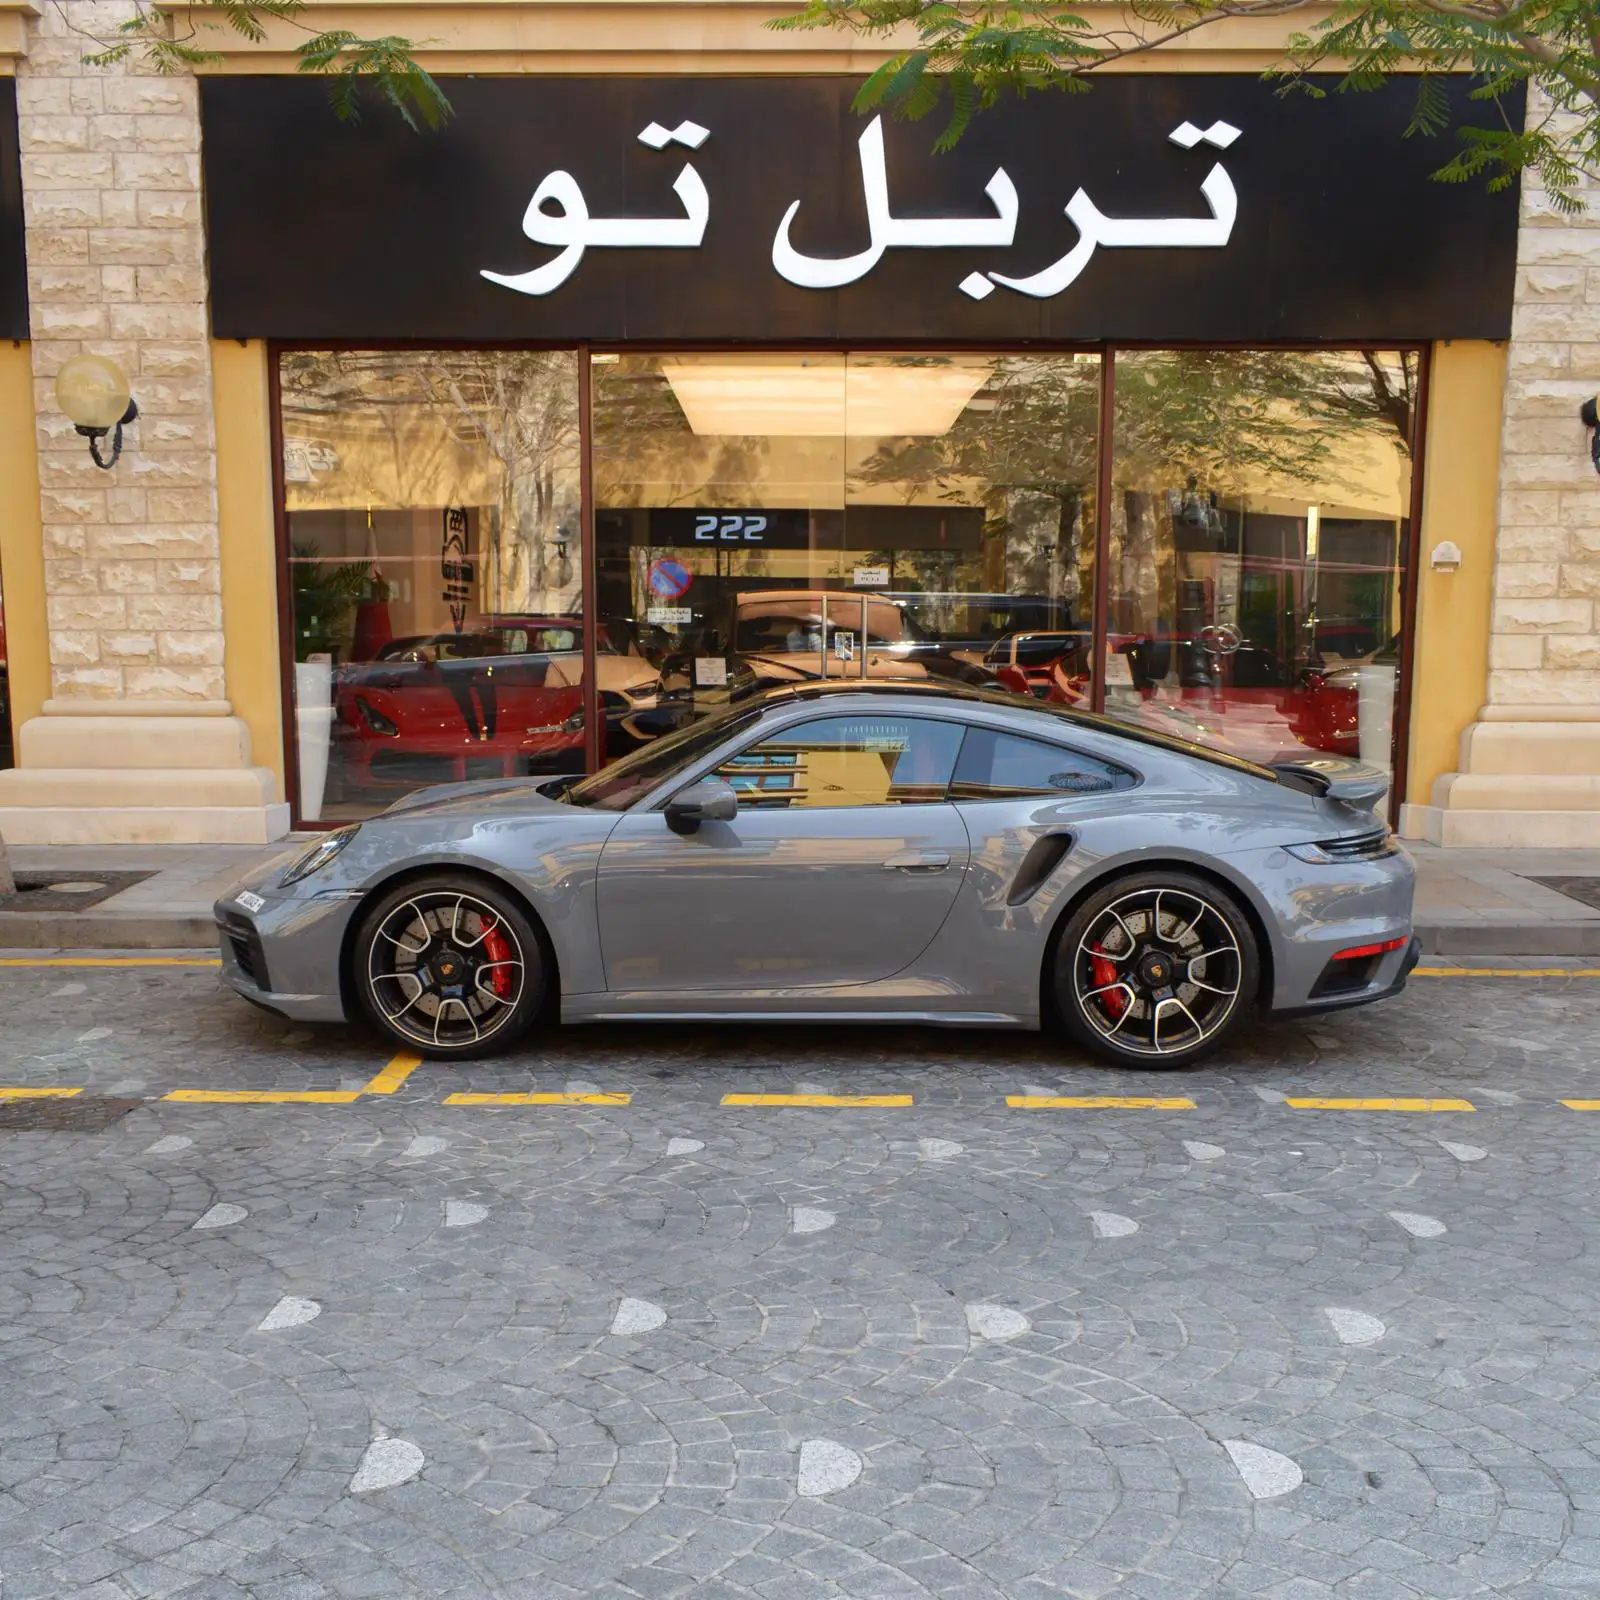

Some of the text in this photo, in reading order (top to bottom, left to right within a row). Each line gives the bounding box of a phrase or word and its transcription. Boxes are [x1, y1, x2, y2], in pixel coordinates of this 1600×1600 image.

[479, 113, 1243, 300] تربل تو
[695, 515, 767, 540] 222
